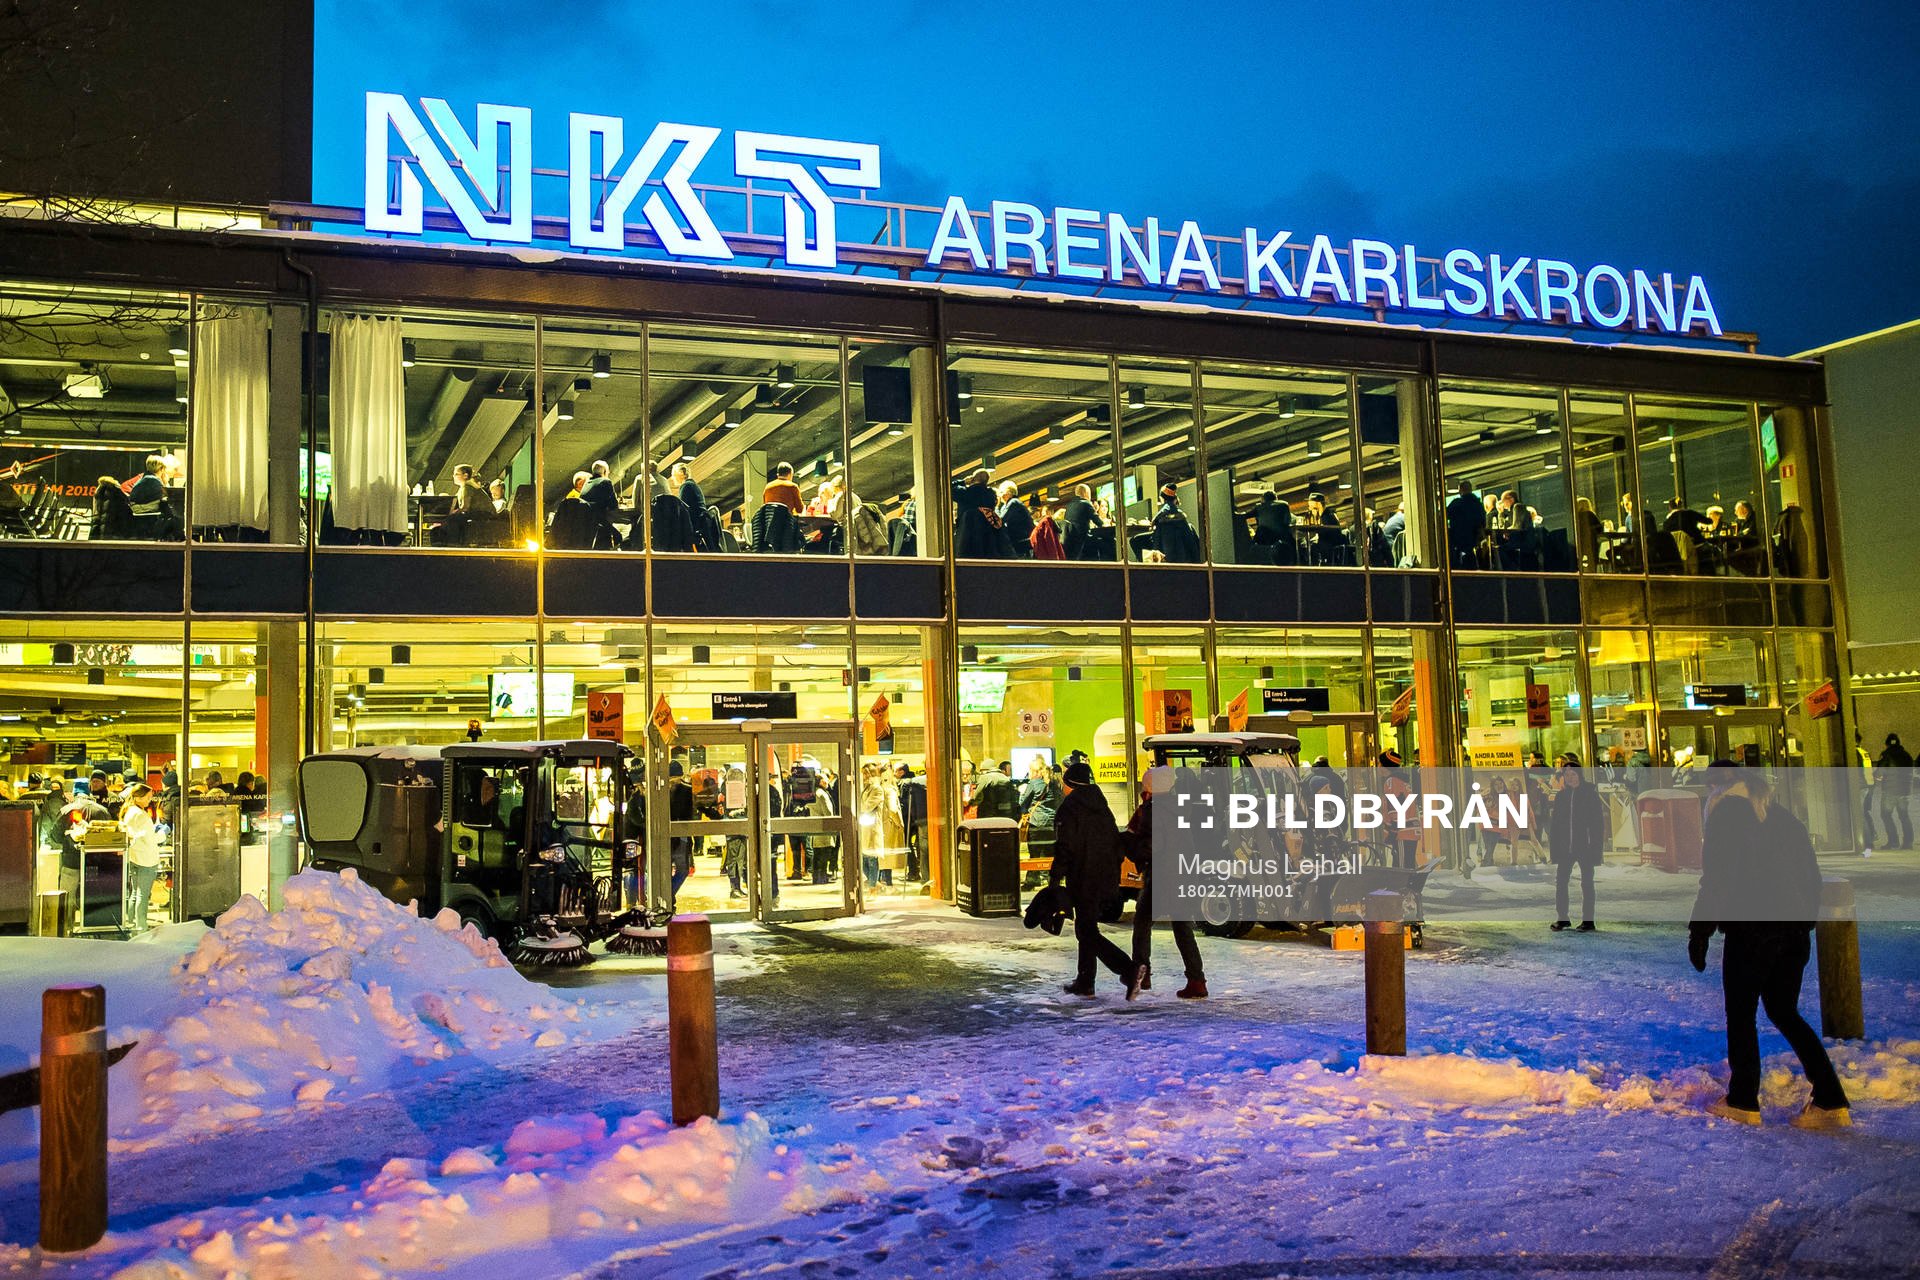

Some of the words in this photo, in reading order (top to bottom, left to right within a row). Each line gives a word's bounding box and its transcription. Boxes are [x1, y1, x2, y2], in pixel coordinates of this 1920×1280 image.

[365, 91, 880, 268] NKT
[926, 195, 1222, 292] ARENA
[1244, 226, 1724, 337] KARLSKRONA
[66, 485, 96, 497] 2018
